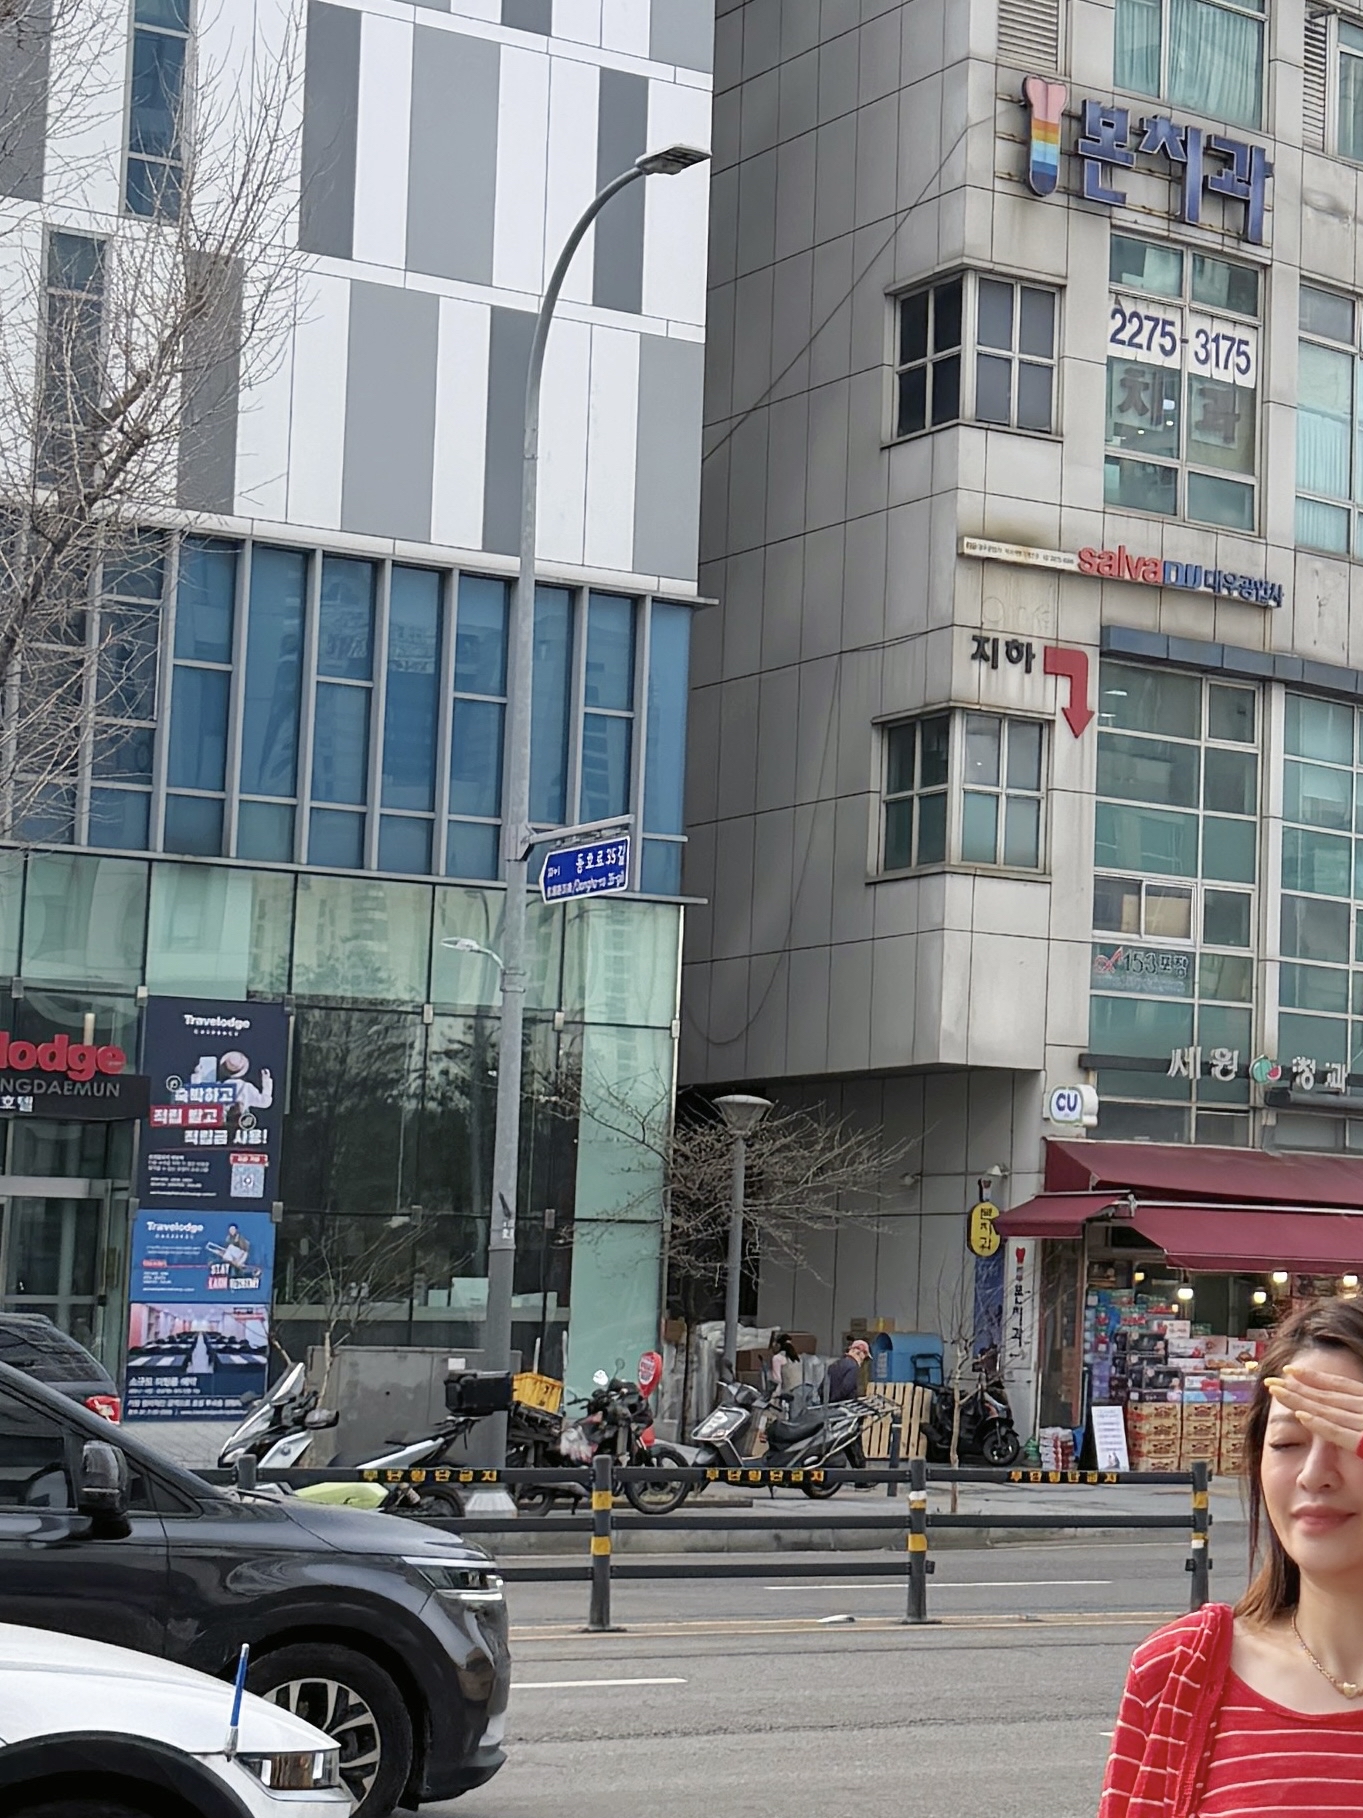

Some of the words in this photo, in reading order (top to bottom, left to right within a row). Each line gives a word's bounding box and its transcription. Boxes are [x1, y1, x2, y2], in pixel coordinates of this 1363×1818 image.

[1109, 307, 1251, 376] 2275-3175
[971, 634, 1035, 674] 지하
[184, 1014, 250, 1030] Travelodge
[1056, 1092, 1078, 1112] CU
[146, 1221, 204, 1233] Travelodge
